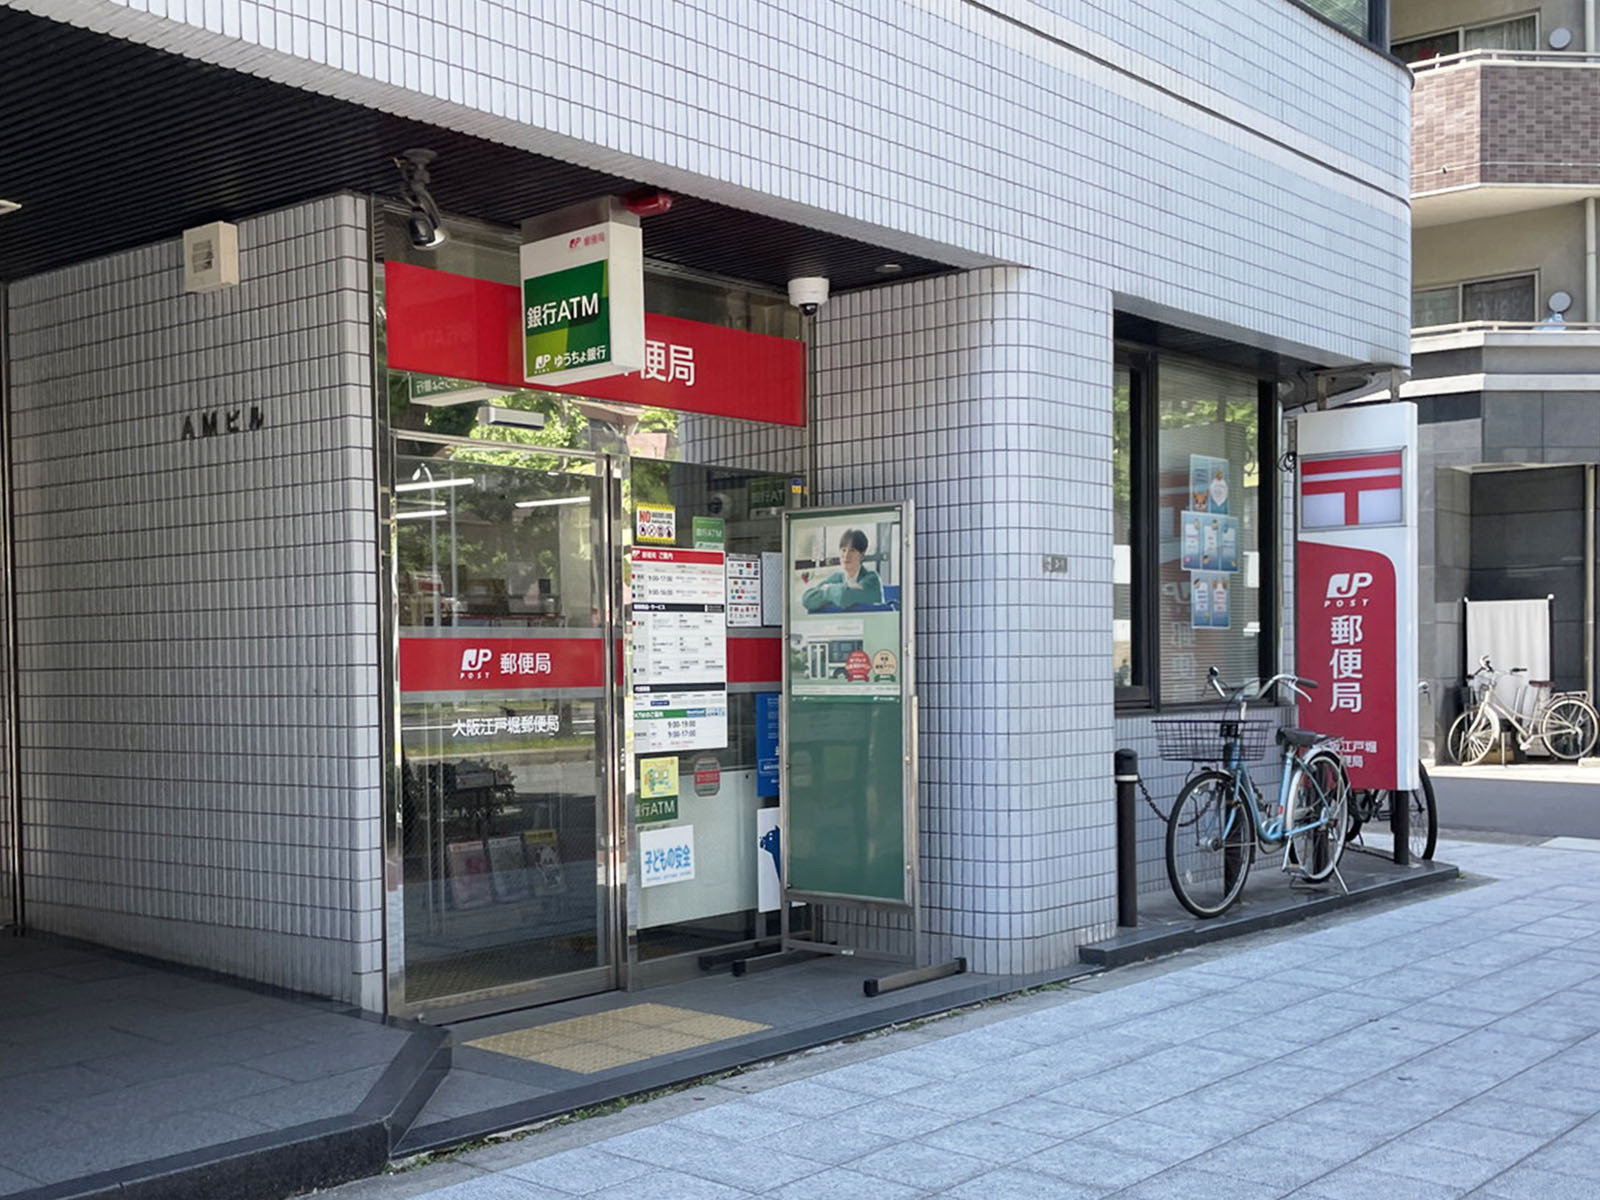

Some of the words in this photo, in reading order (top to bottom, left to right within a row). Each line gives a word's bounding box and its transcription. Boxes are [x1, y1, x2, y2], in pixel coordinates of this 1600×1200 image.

[526, 292, 600, 329] 銀行ATM
[553, 345, 607, 369] ゆうちょ銀行
[1326, 572, 1373, 599] JP
[1323, 598, 1369, 608] POST
[500, 652, 551, 675] 郵便局
[1329, 614, 1363, 713] 郵便局
[452, 715, 560, 737] 大阪江戸堀郵便局
